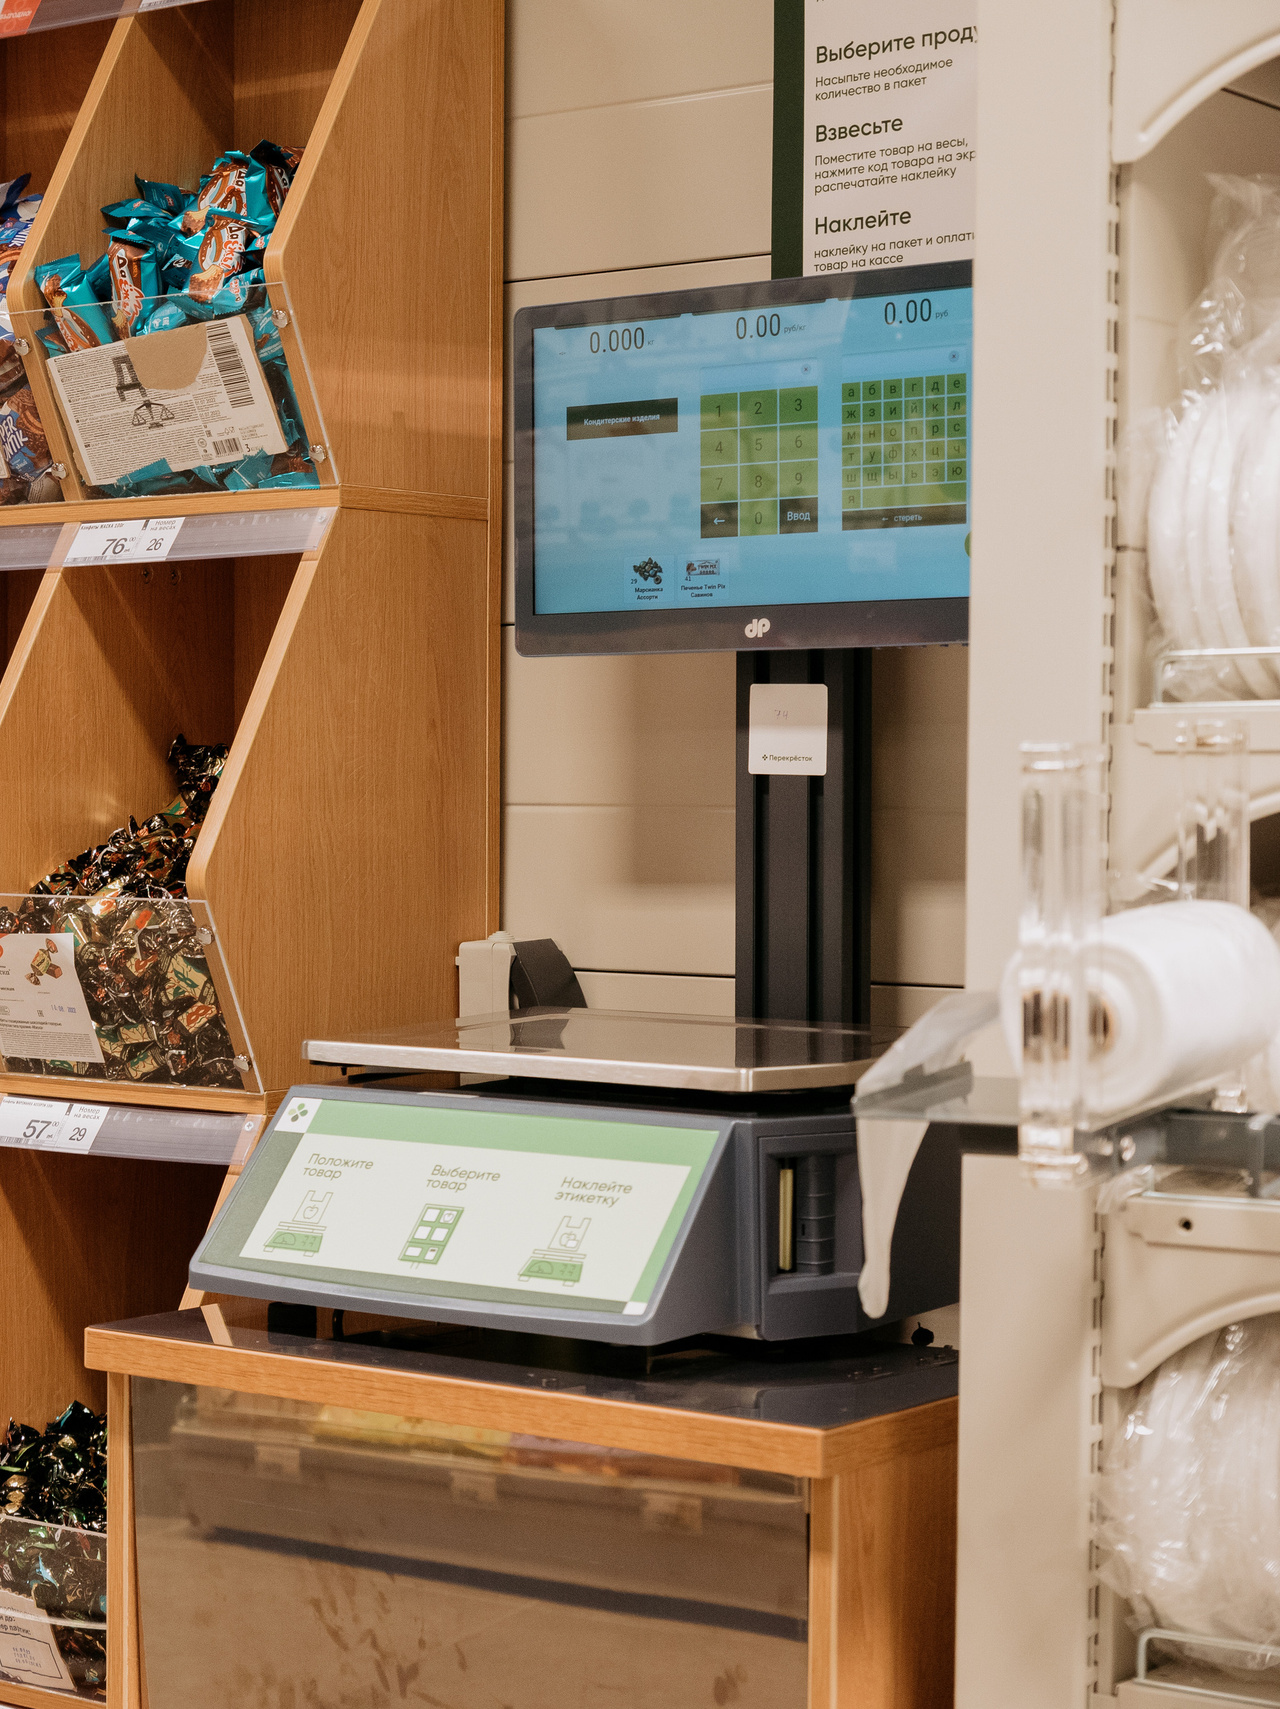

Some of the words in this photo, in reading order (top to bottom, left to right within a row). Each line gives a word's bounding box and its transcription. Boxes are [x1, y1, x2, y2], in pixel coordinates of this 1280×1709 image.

[816, 35, 915, 64] Выберите
[815, 71, 870, 87] Насыпьте
[873, 58, 953, 78] необходимое
[815, 84, 881, 101] количество
[884, 82, 891, 91] в
[893, 76, 927, 89] пакет
[816, 118, 903, 142] Взвесьте
[815, 150, 876, 166] Поместите
[880, 145, 915, 158] товар
[918, 142, 933, 152] на
[936, 138, 968, 150] весы,
[815, 164, 865, 180] нажмите
[868, 161, 888, 174] код
[891, 155, 934, 170] товара
[937, 153, 952, 164] на
[814, 174, 898, 196] распечатайте
[901, 166, 957, 183] наклейку
[815, 209, 912, 235] Наклейте
[814, 243, 869, 259] наклейку
[871, 242, 886, 252] на
[889, 238, 923, 250] пакет
[926, 236, 933, 246] и
[814, 260, 849, 273] товар
[852, 258, 866, 268] на
[869, 254, 904, 267] кассе
[884, 298, 932, 325] 0.00
[736, 313, 781, 340] 0.00
[590, 327, 645, 354] 0.000
[716, 405, 720, 417] 1
[754, 402, 762, 414] 2
[795, 398, 802, 411] 3
[584, 415, 631, 427] Кондитерские
[632, 414, 660, 424] изделия
[715, 441, 723, 453] 4
[755, 438, 762, 451] 5
[795, 436, 802, 448] 6
[715, 478, 723, 490] 7
[755, 475, 762, 488] 8
[795, 473, 802, 485] 9
[755, 512, 762, 525] 0
[787, 511, 811, 521] Ввод
[894, 515, 922, 523] стереть
[102, 538, 128, 555] 76
[146, 538, 164, 552] 26
[769, 755, 813, 763] Перекрёсток
[23, 1119, 52, 1139] 57
[69, 1127, 87, 1141] 29
[307, 1153, 374, 1172] Положите
[302, 1167, 343, 1182] товар
[431, 1164, 501, 1183] Выберите
[425, 1178, 468, 1193] товар
[560, 1176, 634, 1195] Наклейте
[554, 1191, 620, 1208] этикетку
